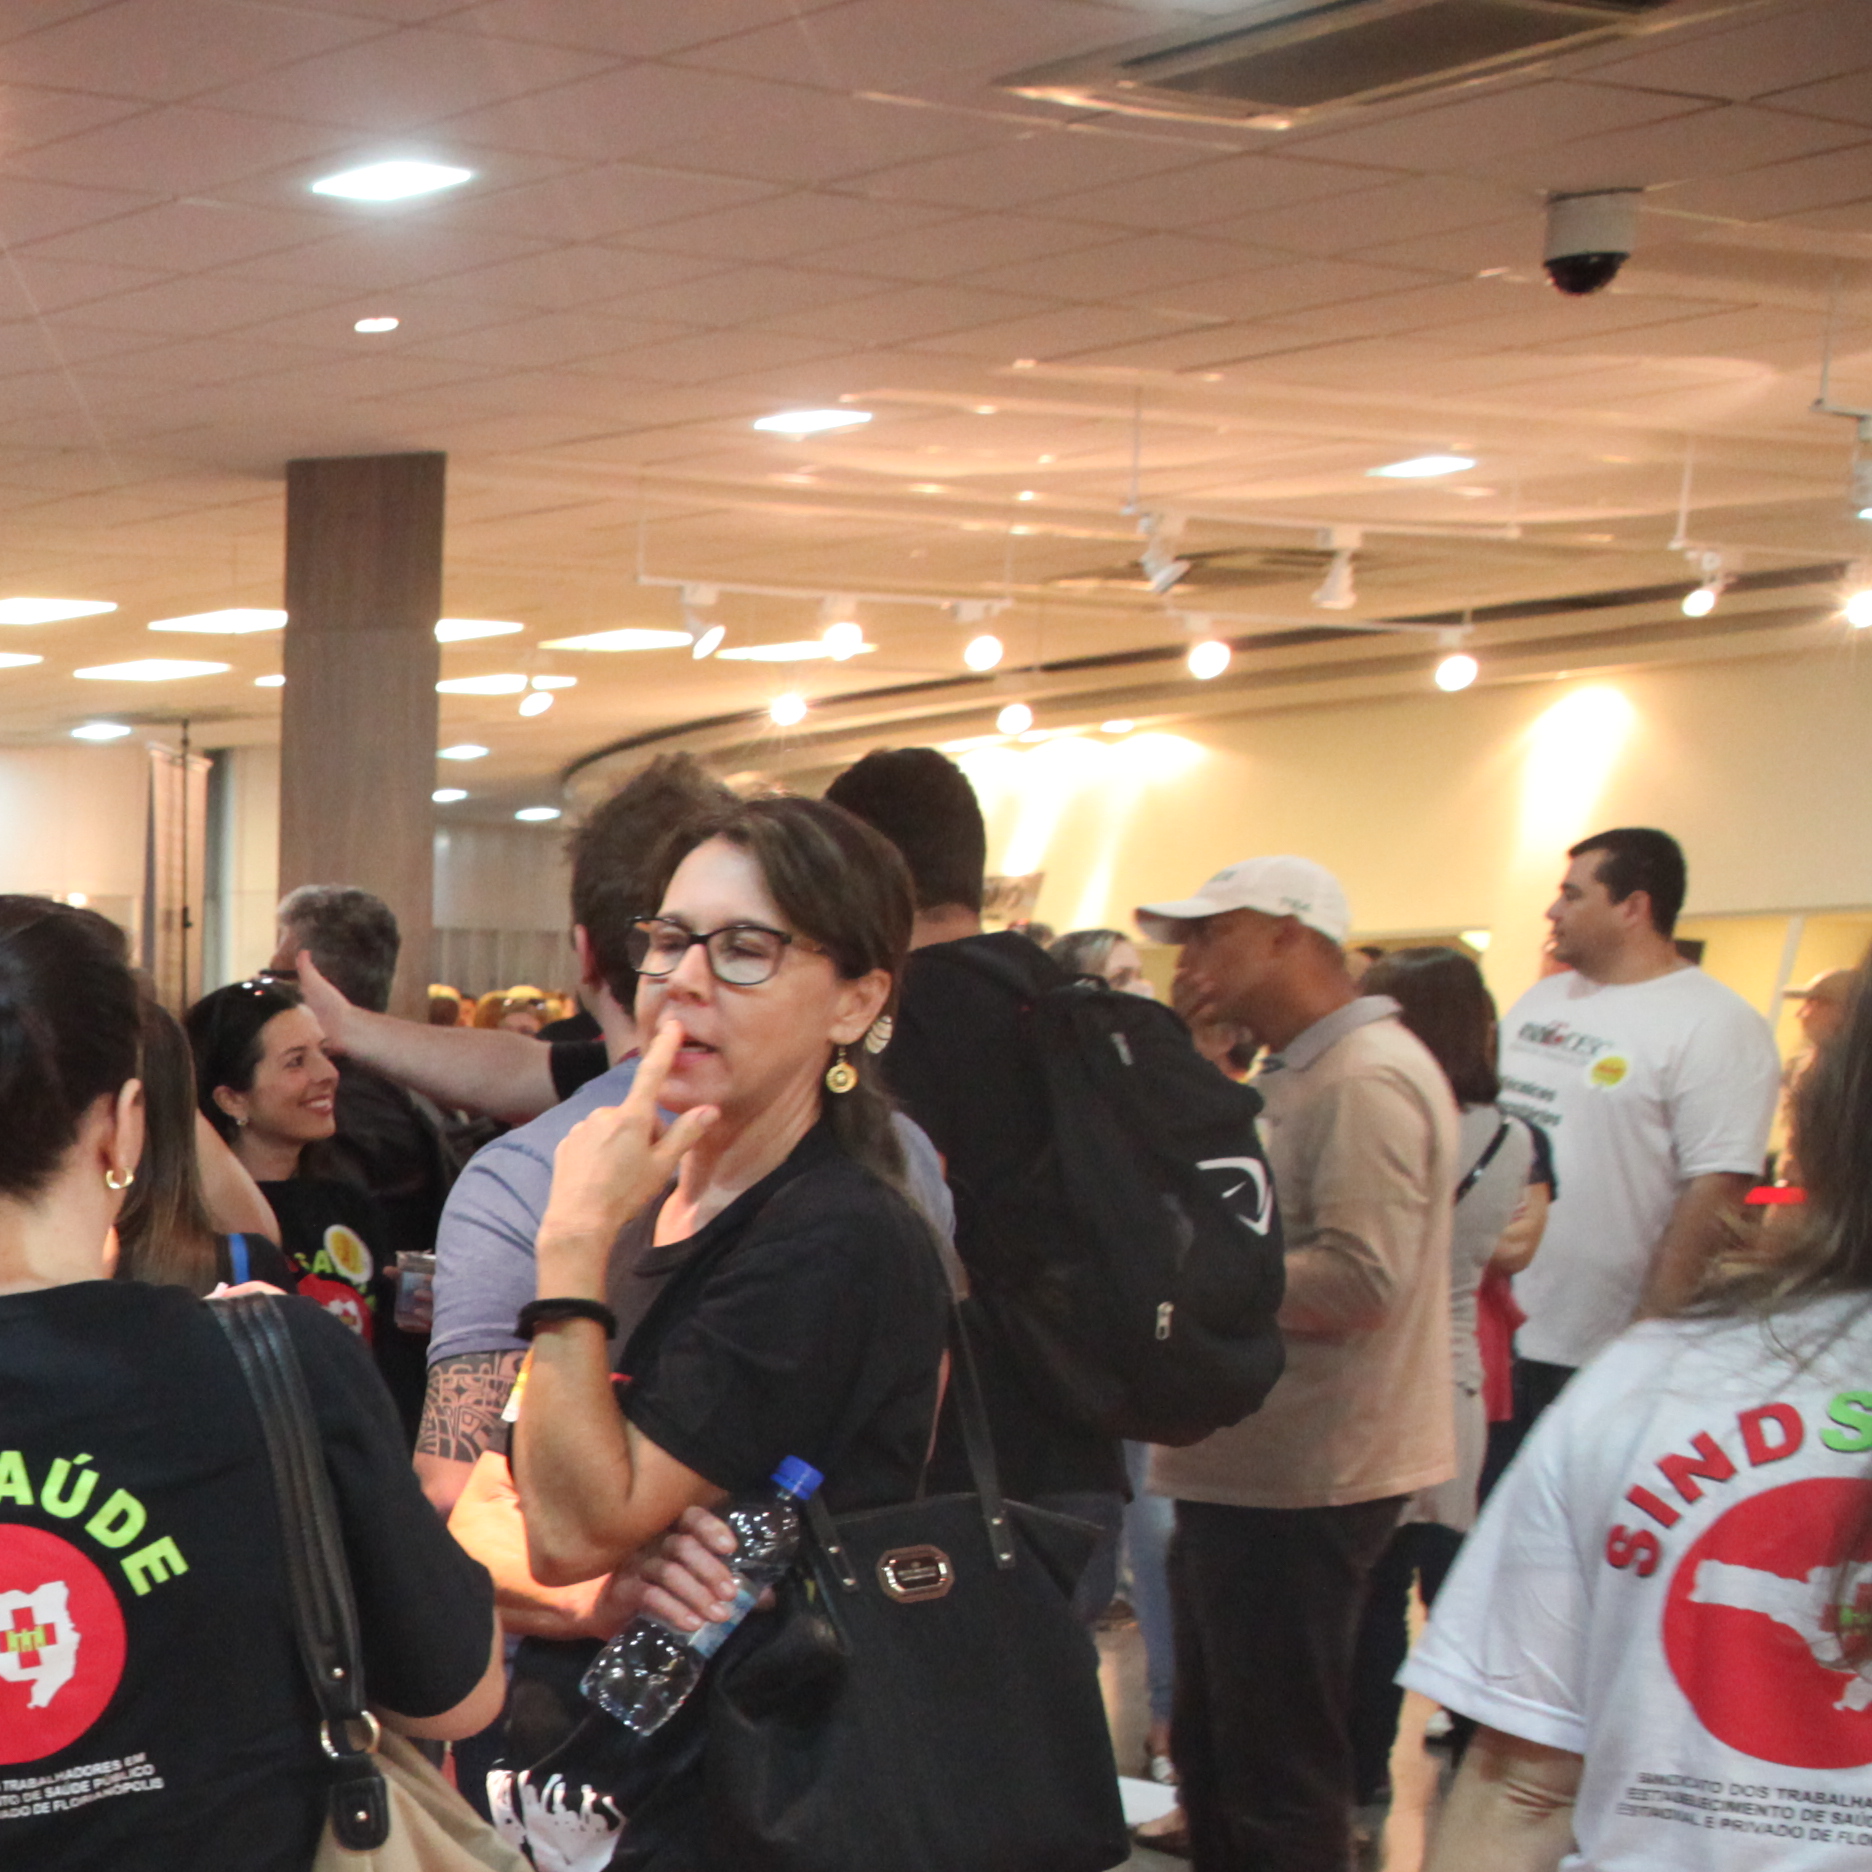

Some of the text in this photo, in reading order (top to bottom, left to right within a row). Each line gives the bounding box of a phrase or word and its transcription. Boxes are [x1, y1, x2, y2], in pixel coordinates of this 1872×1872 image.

[2, 1759, 122, 1791] TRABALHADORES
[124, 1752, 146, 1767] EM
[22, 1790, 43, 1802] DE
[44, 1778, 91, 1799] SAÚDE
[92, 1764, 156, 1789] PÚBLICO
[33, 1801, 51, 1815] DE
[52, 1776, 165, 1811] FLORIANÓPOLIS
[1728, 1783, 1769, 1799] DOS
[1704, 1816, 1715, 1829] E
[1720, 1818, 1805, 1839] PRIVADO
[1808, 1827, 1832, 1842] DE
[1800, 1808, 1826, 1823] DE
